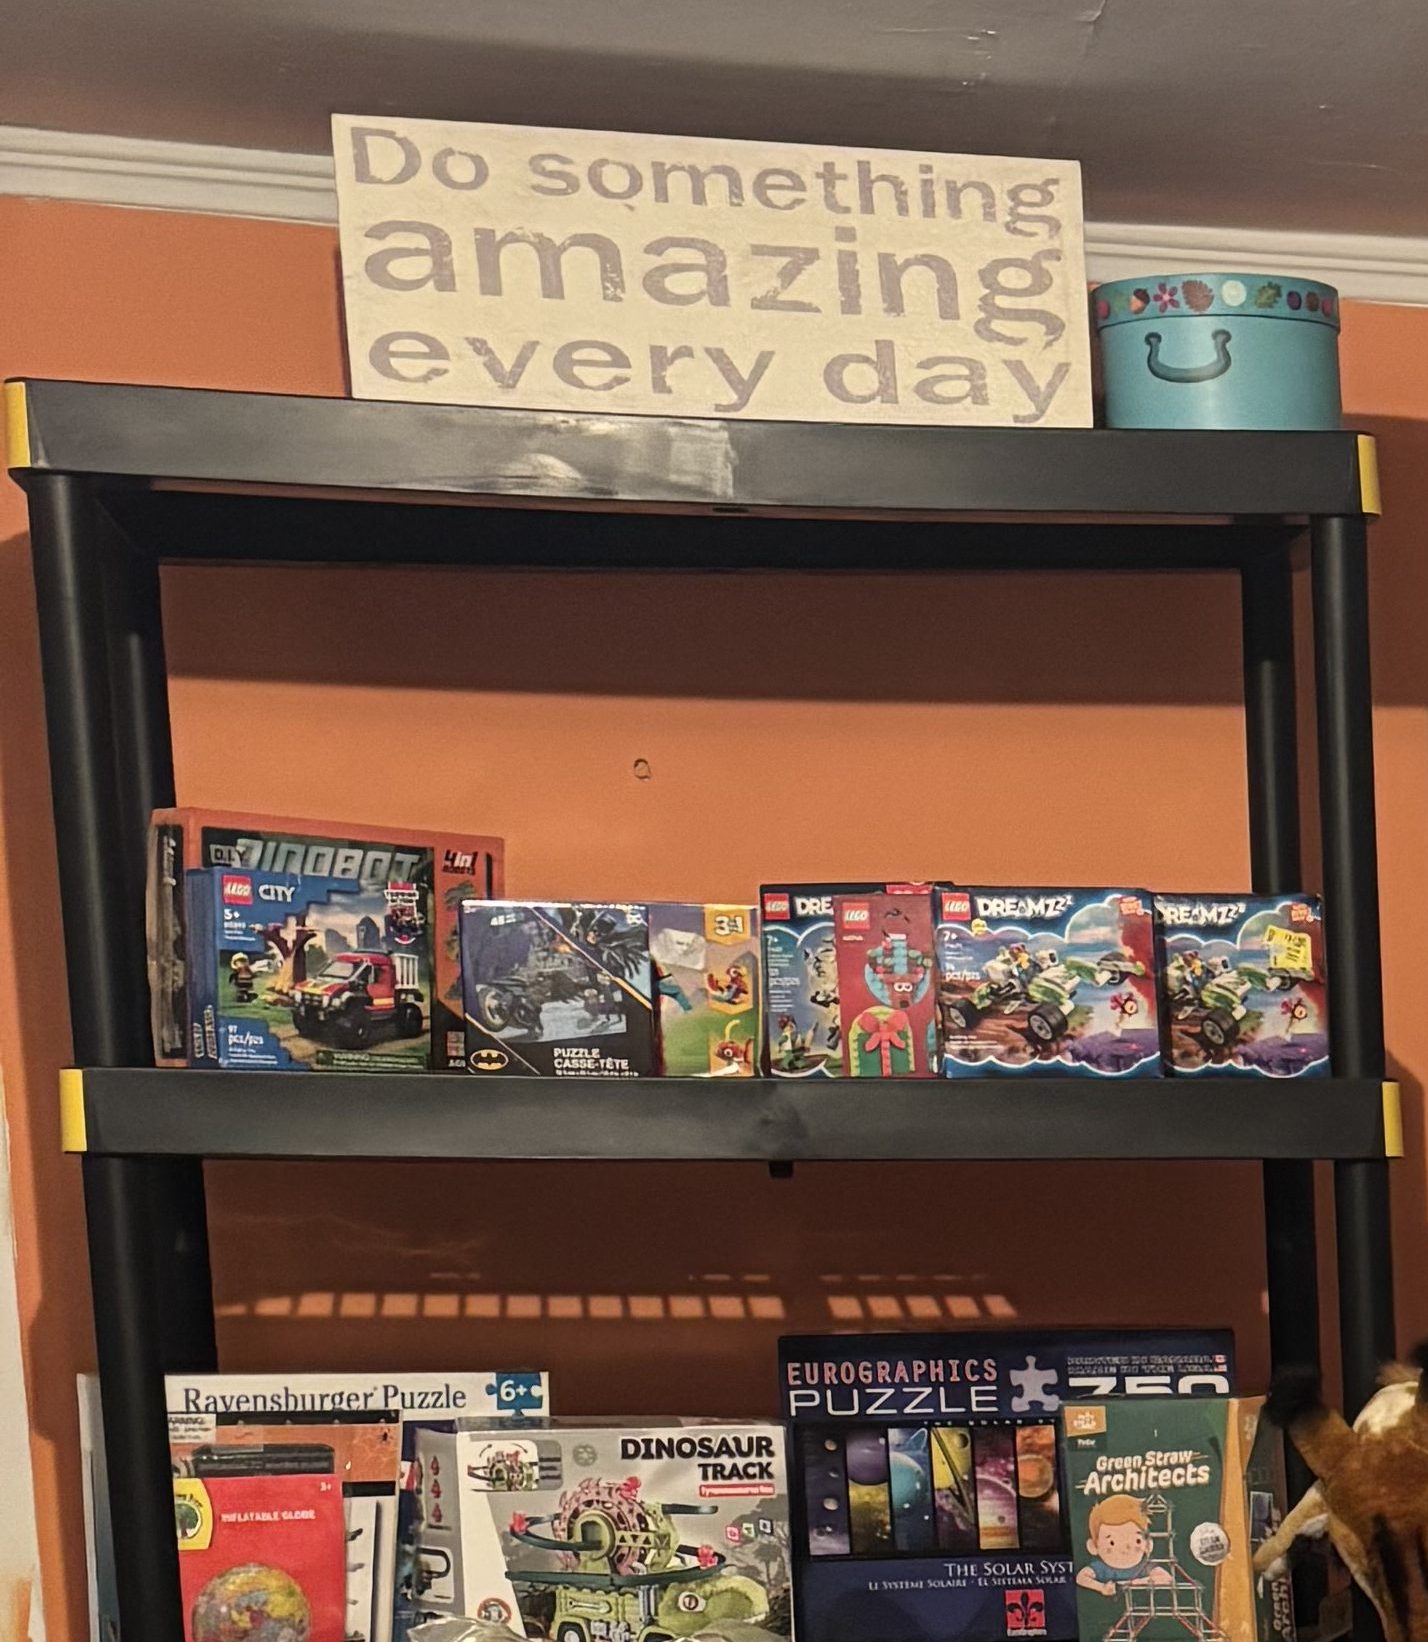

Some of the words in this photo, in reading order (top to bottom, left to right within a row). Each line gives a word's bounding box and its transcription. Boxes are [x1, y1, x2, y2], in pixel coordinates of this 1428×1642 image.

[351, 125, 489, 192] Do
[528, 149, 1063, 238] something
[362, 217, 1066, 349] amazing
[368, 327, 776, 413] every
[823, 338, 1071, 425] day
[224, 882, 252, 897] LEGO
[258, 884, 296, 902] CITY
[764, 899, 789, 912] LEGO
[843, 909, 869, 922] LEGO
[944, 900, 970, 912] LEGO
[553, 1047, 601, 1060] PUZZLE
[553, 1057, 630, 1071] CASSE-TÊTE
[786, 1358, 998, 1387] EUROGRAPHICS
[183, 1385, 376, 1413] Ravensburger
[381, 1383, 467, 1410] Puzzle
[499, 1379, 528, 1401] 6+
[788, 1385, 1000, 1417] PUZZLE
[620, 1436, 777, 1461] DINOSAUR
[697, 1461, 775, 1482] TRACK
[1095, 1453, 1143, 1473] Green
[1144, 1449, 1194, 1468] Straw
[1082, 1462, 1211, 1497] Architects
[943, 1562, 978, 1578] THE
[983, 1561, 1035, 1577] SOLAR
